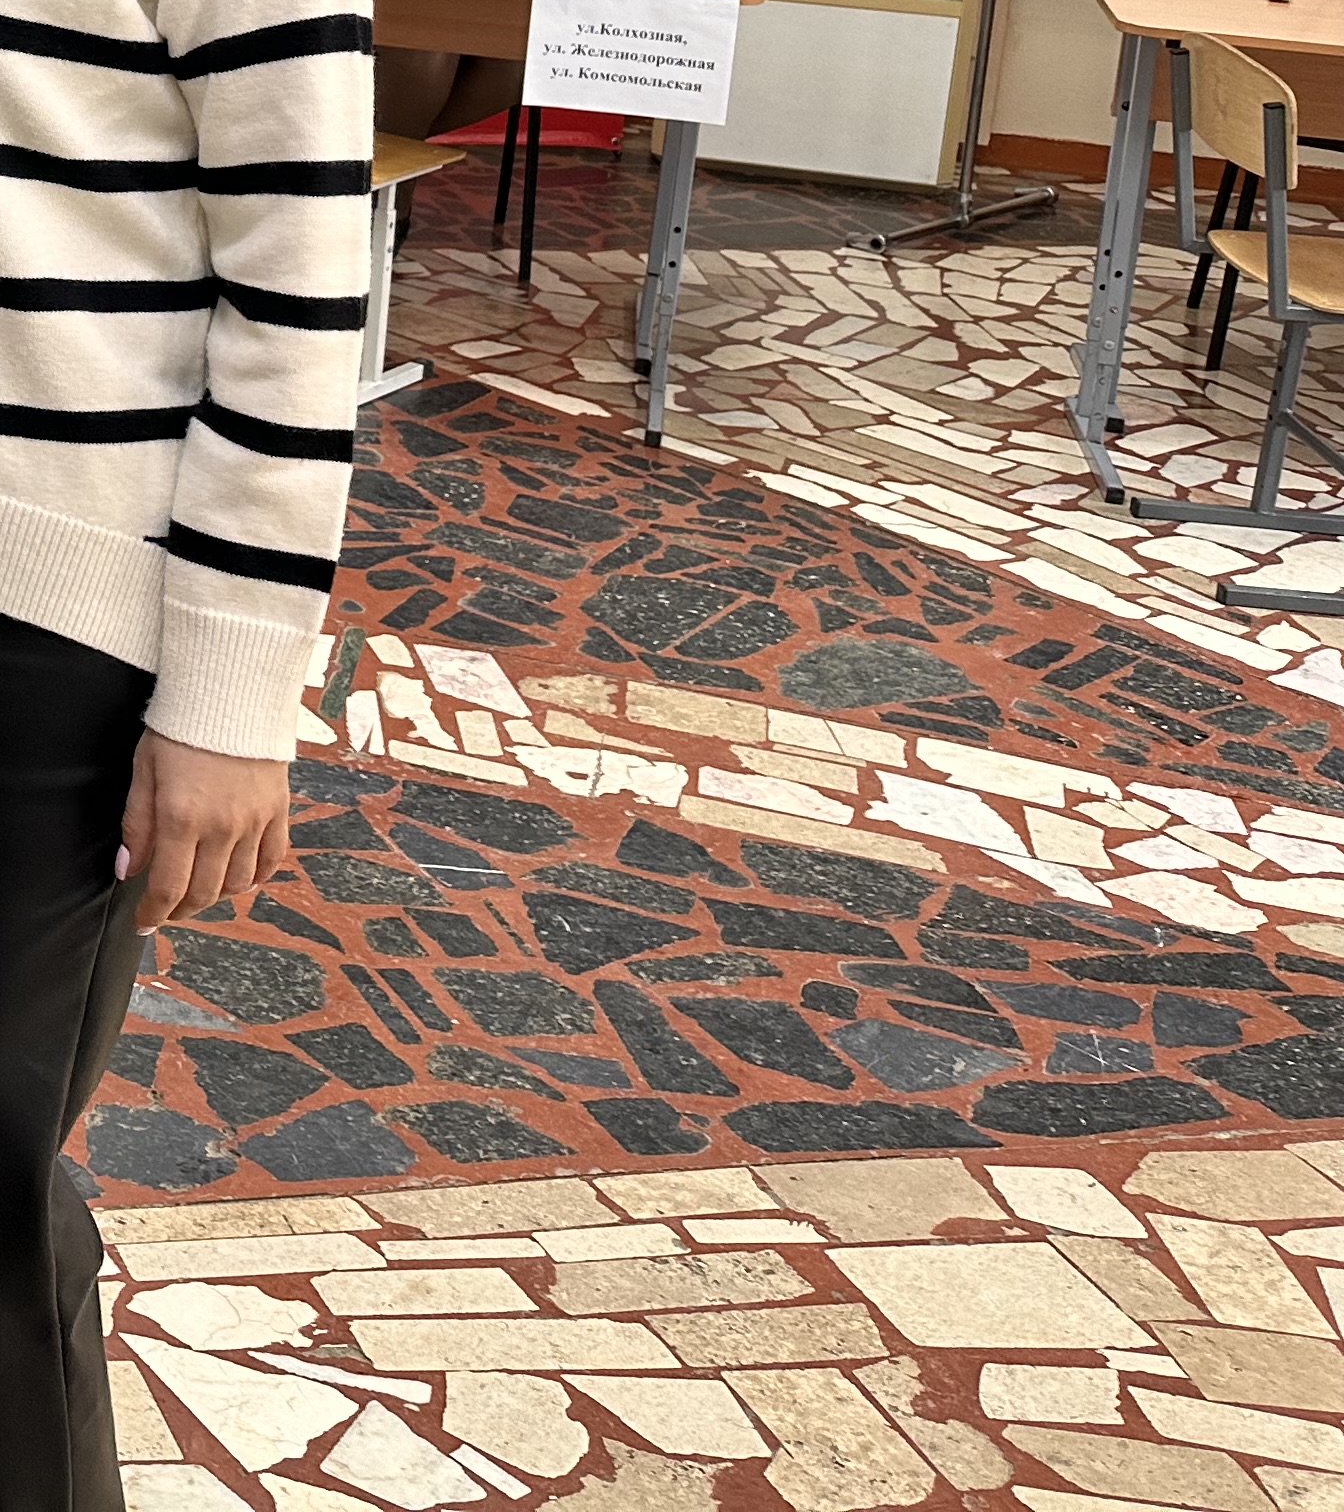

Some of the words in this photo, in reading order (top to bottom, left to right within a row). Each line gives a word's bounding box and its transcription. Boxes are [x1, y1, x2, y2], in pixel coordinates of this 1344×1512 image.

[543, 42, 566, 56] ул.
[570, 43, 715, 71] Железнодорожная
[551, 67, 573, 80] ул.
[579, 68, 702, 93] Комсомольская
